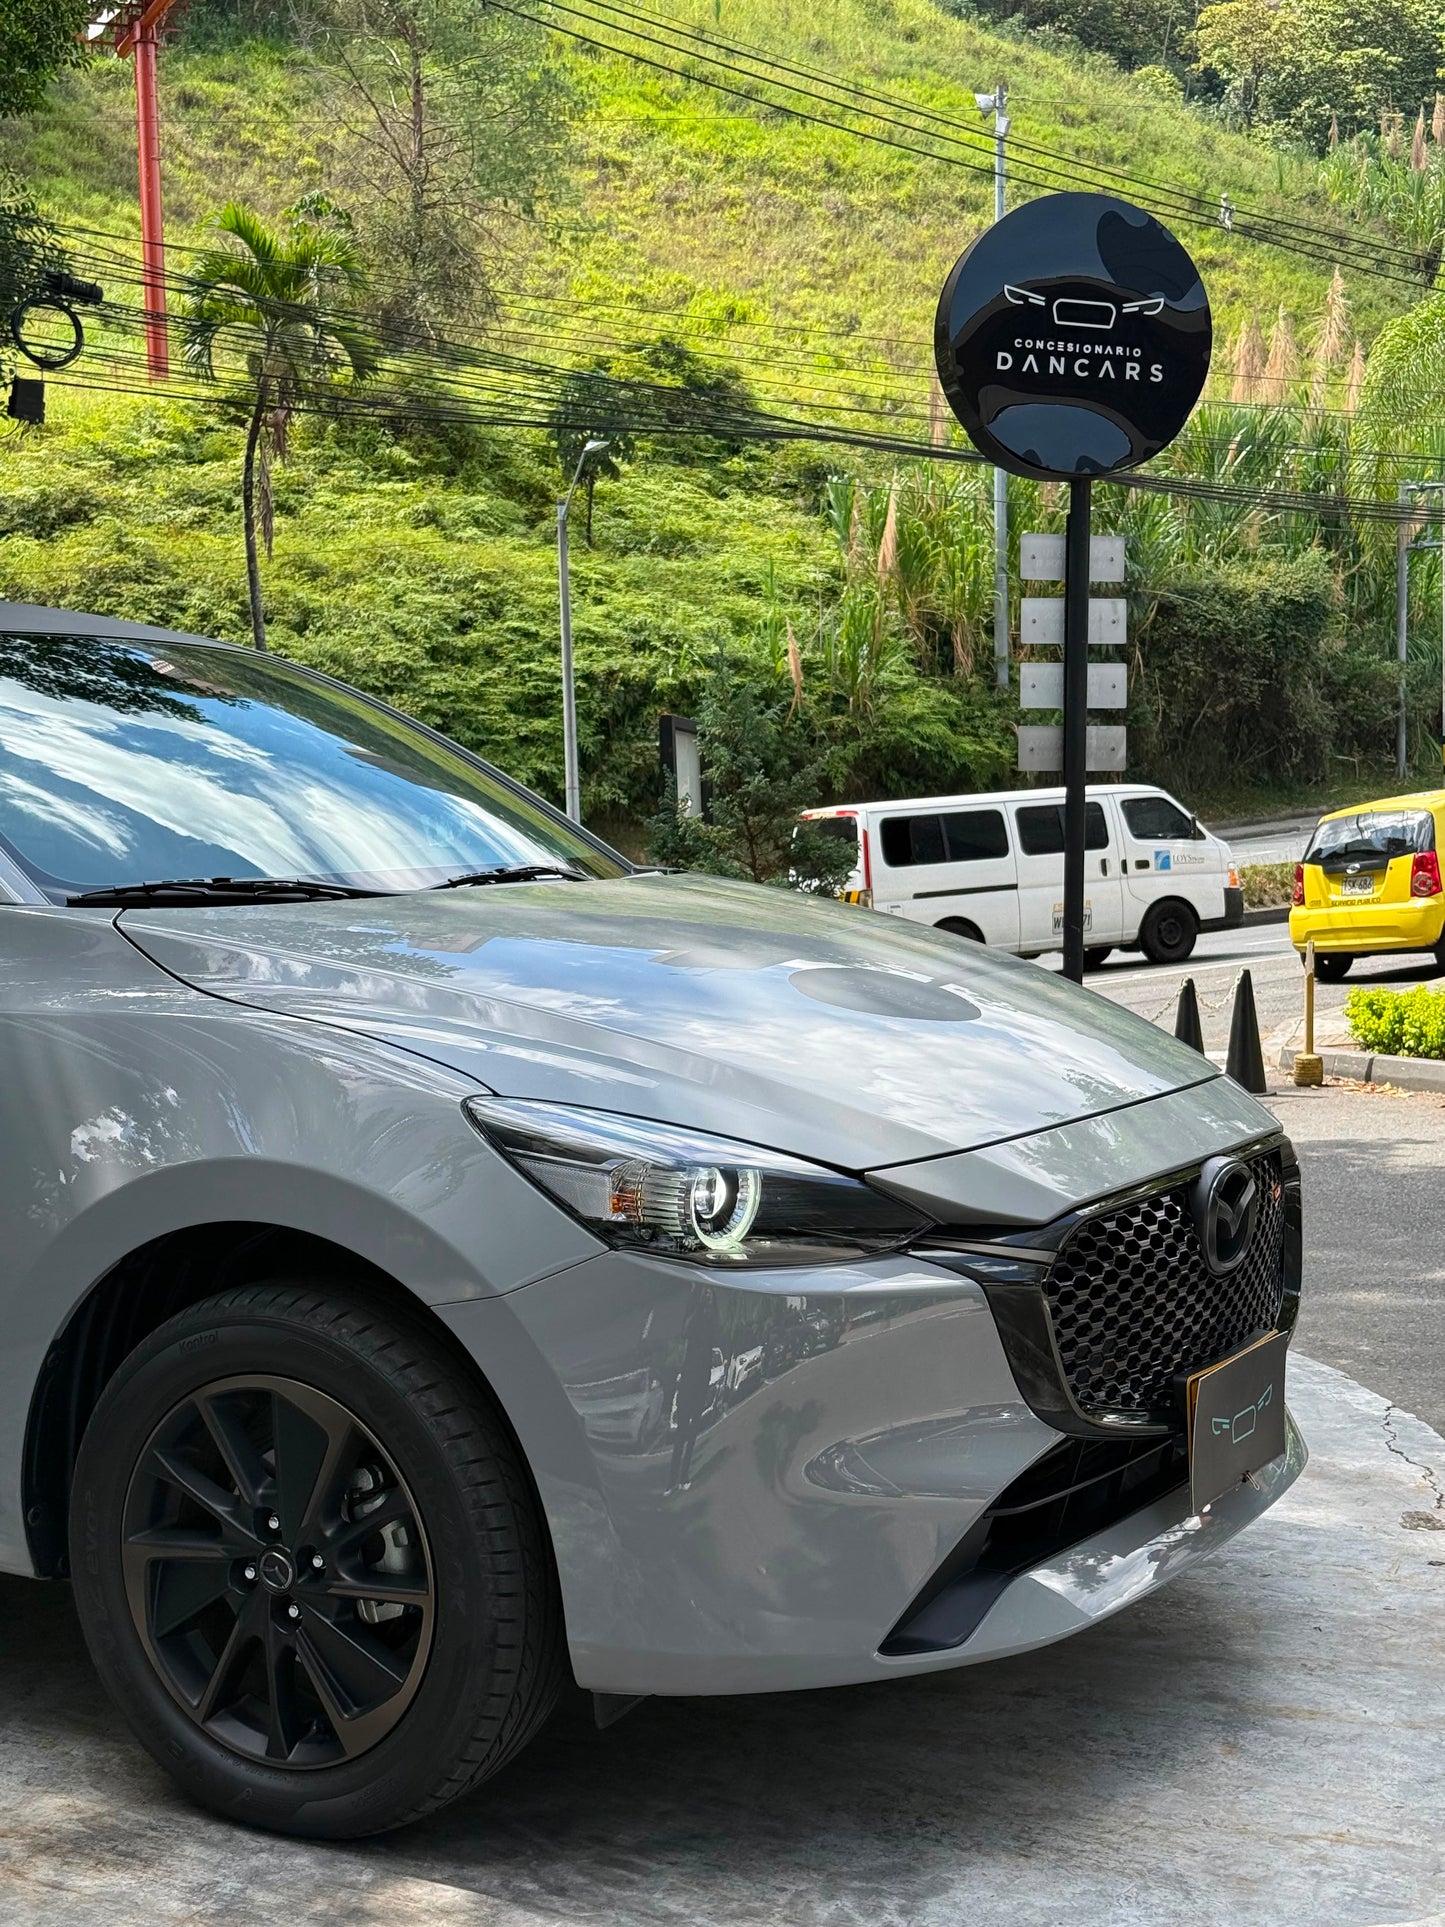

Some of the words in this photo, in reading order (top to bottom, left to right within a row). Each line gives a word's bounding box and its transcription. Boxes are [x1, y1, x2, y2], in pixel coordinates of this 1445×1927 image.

[1014, 338, 1142, 357] CONCESIONARIO
[997, 352, 1163, 382] DANCARS
[179, 1330, 218, 1354] Kontrol
